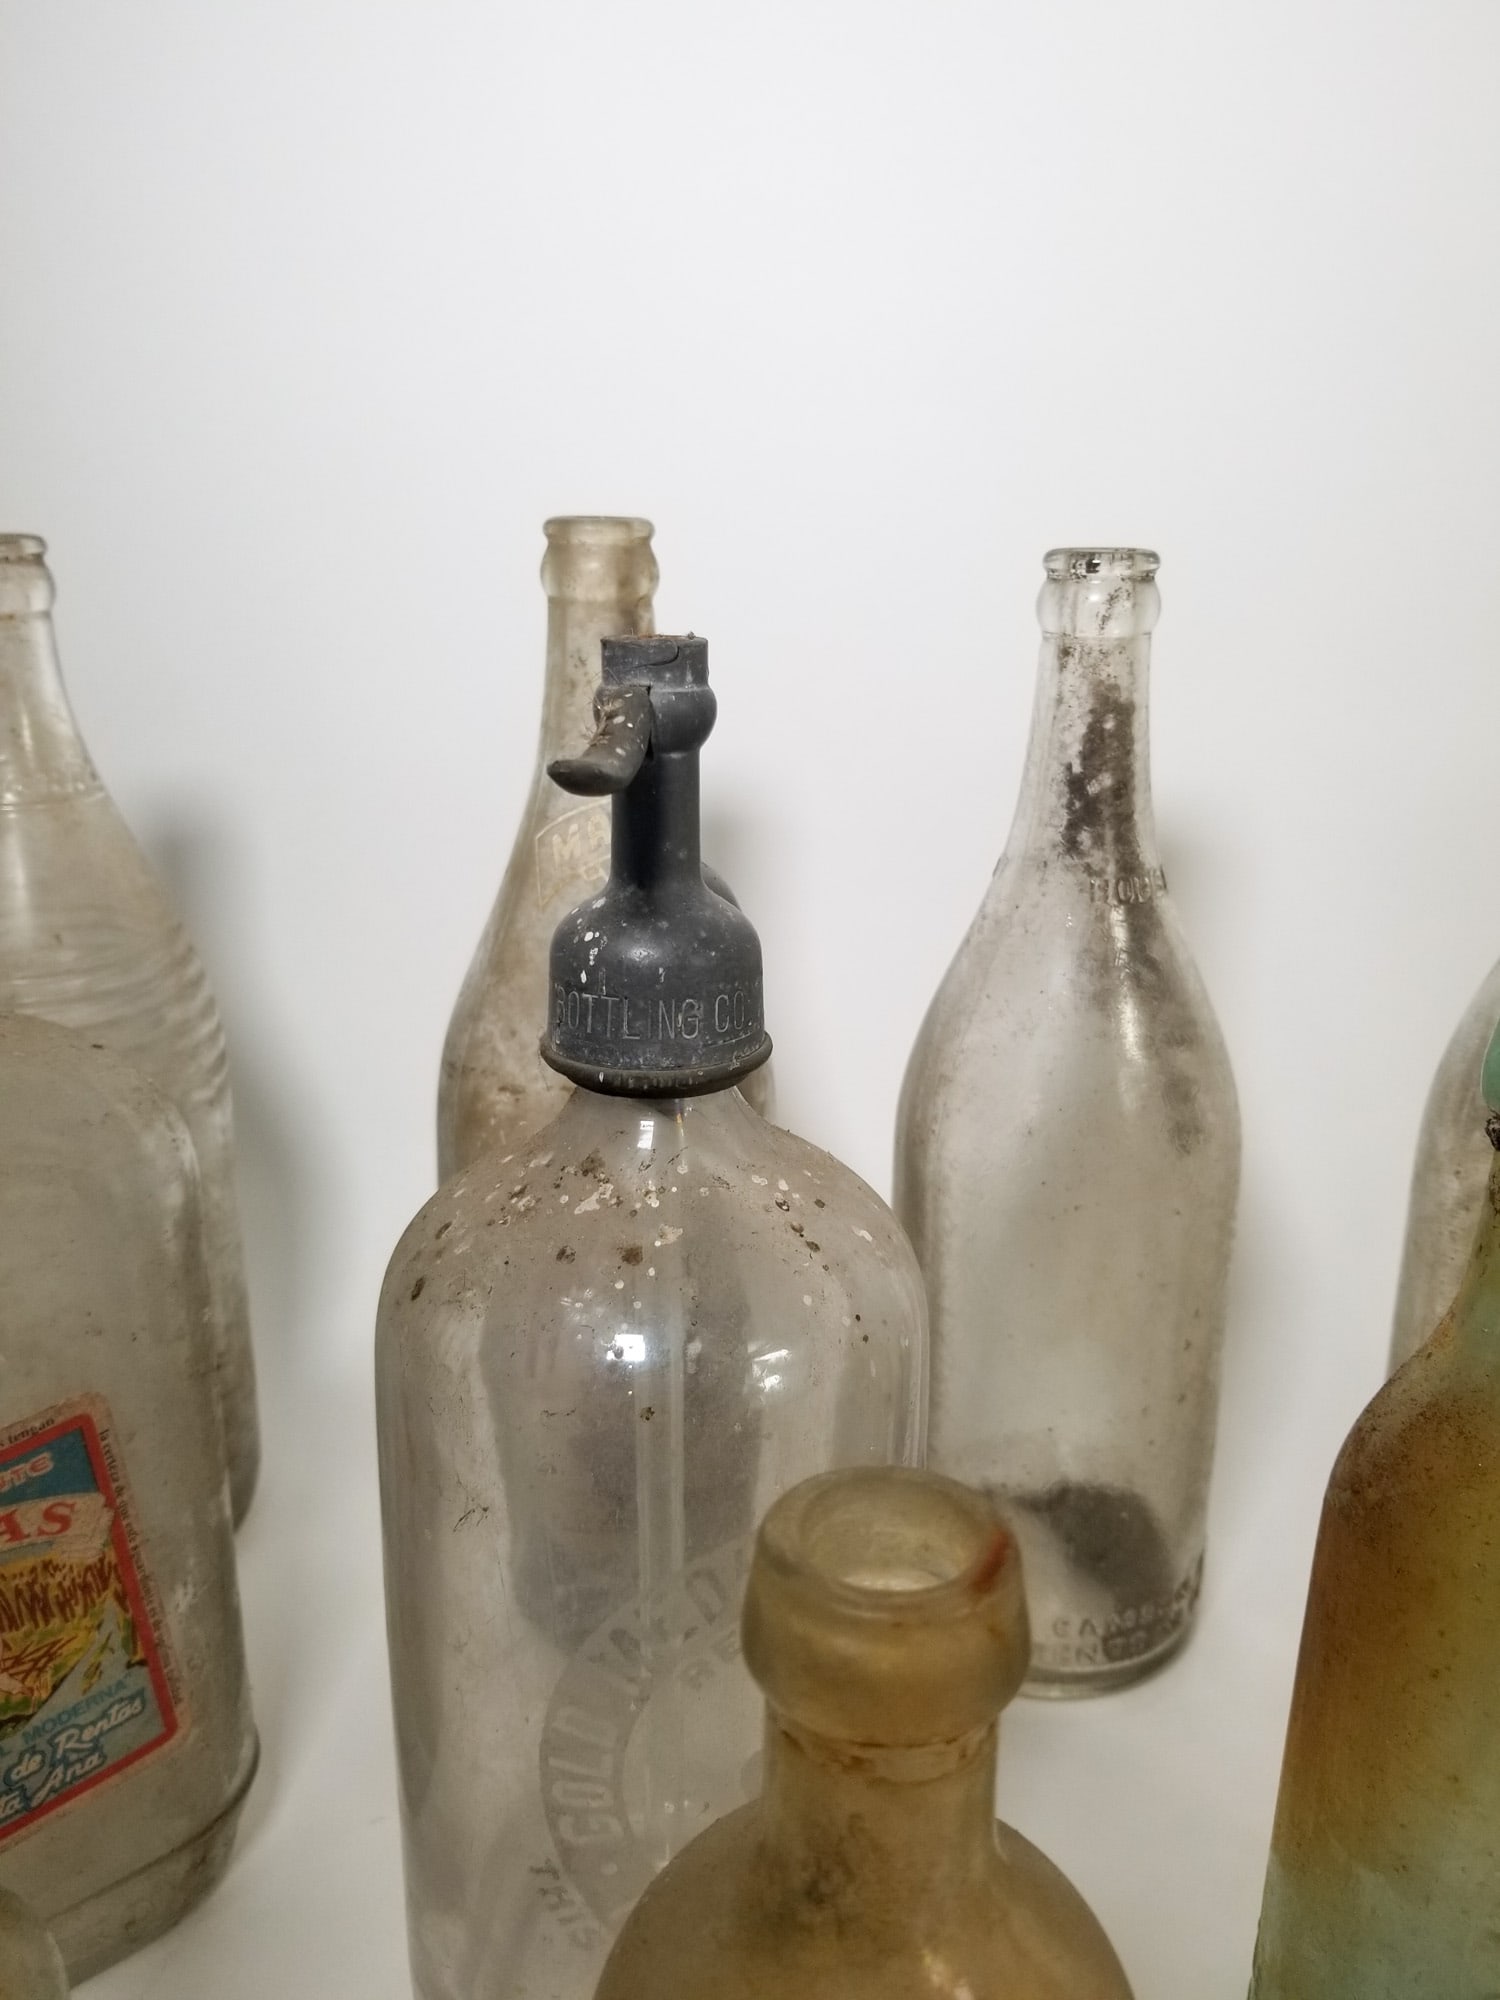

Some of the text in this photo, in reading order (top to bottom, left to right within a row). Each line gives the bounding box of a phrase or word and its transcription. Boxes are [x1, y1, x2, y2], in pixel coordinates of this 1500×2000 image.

[555, 984, 700, 1041] BOTTLING
[9, 1696, 143, 1781] de Rentas
[30, 1750, 101, 1808] Ana
